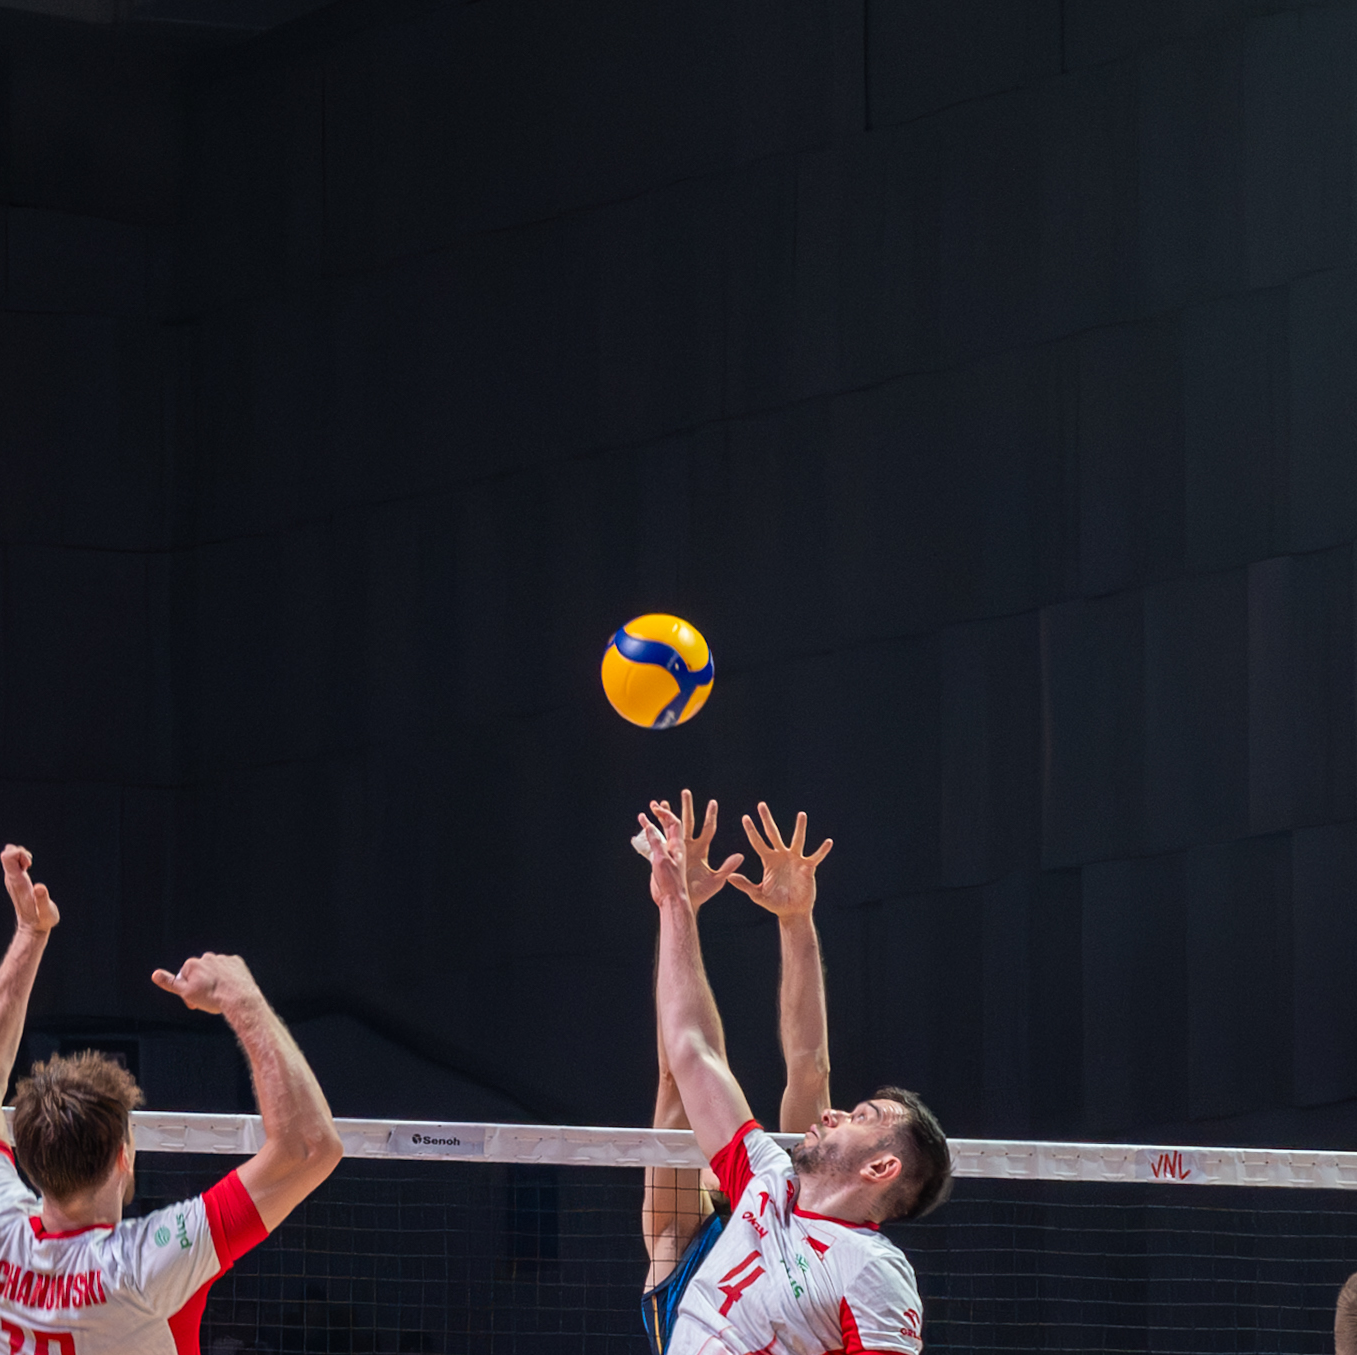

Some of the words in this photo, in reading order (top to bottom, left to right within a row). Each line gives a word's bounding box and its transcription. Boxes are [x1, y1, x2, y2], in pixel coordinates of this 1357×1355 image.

[423, 1134, 461, 1148] Senoh
[1151, 1150, 1191, 1181] VNL
[175, 1212, 193, 1250] plus
[717, 1249, 766, 1318] 4
